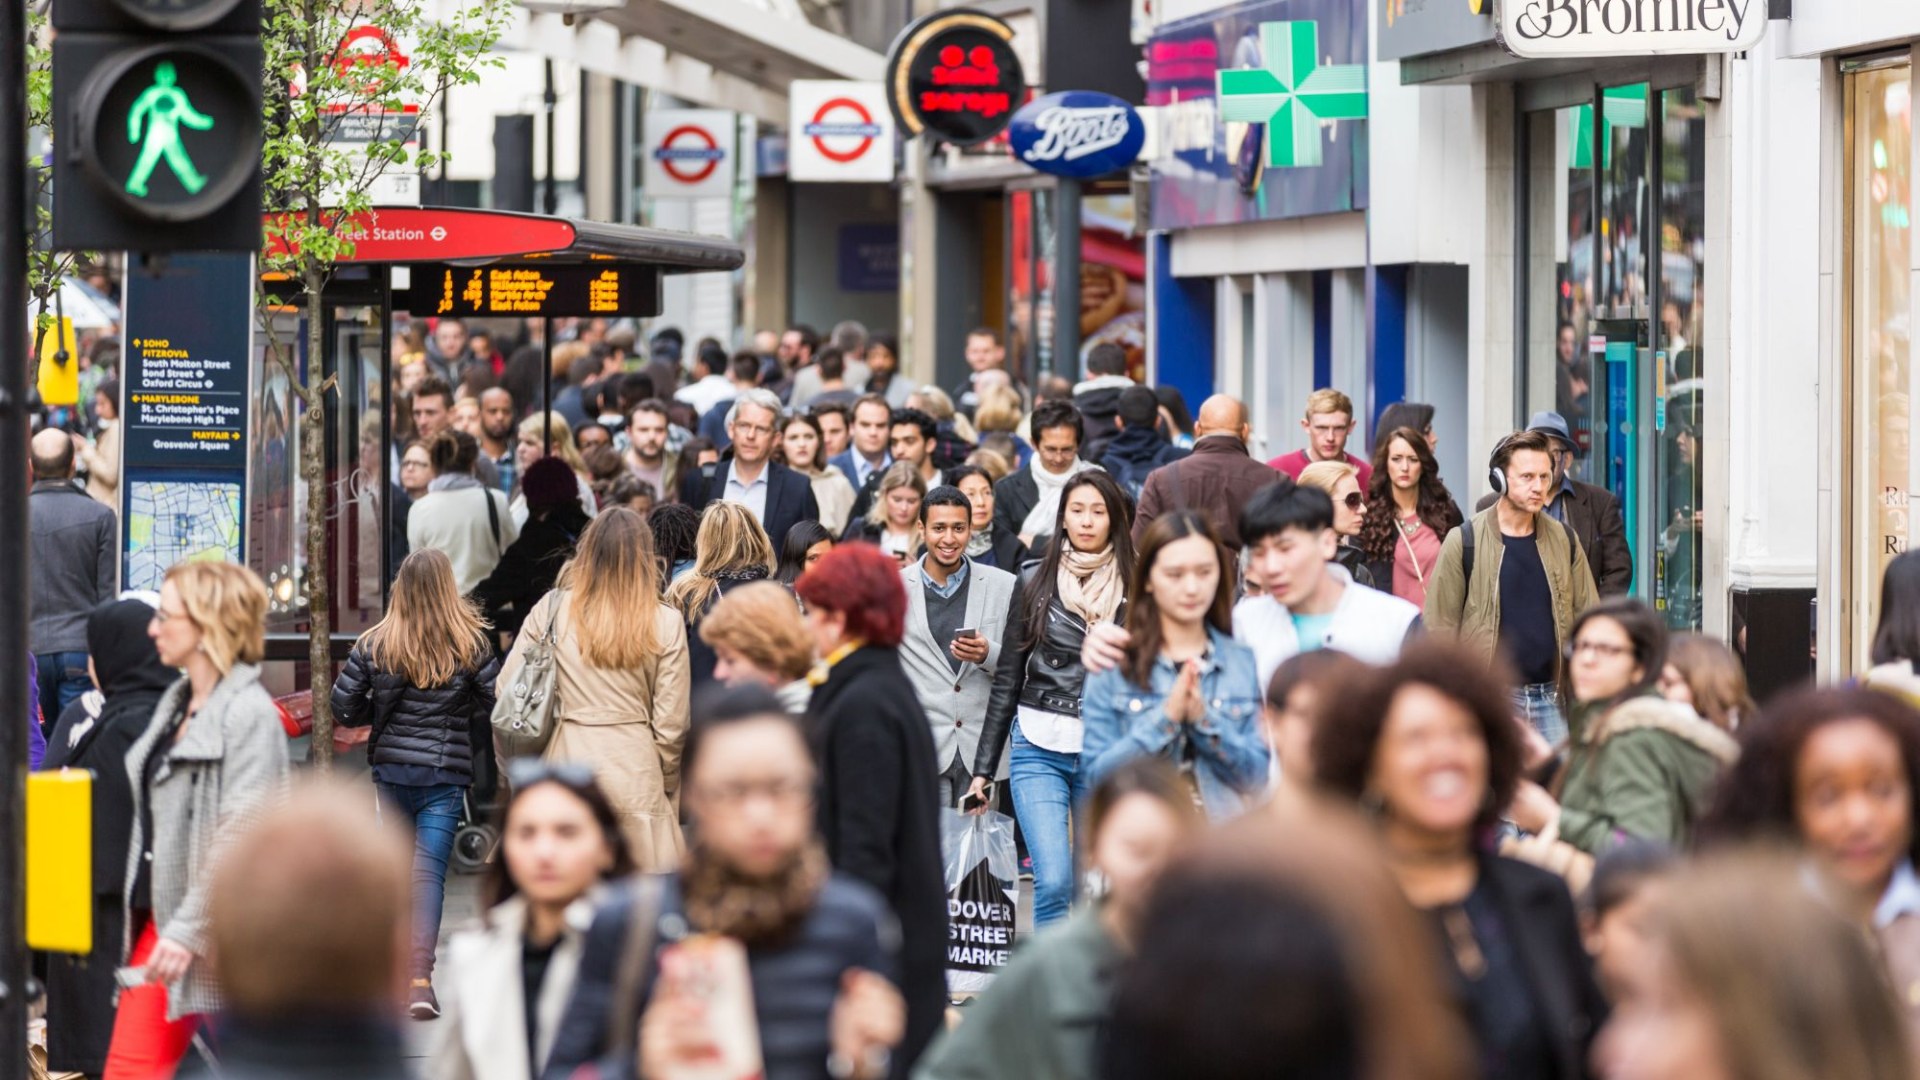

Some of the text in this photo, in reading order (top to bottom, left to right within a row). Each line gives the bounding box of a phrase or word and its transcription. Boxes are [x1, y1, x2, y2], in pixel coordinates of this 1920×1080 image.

[1024, 106, 1130, 161] Boots
[373, 227, 424, 241] Station
[143, 339, 169, 348] SOHO
[142, 349, 189, 358] FITZROVIA
[142, 359, 231, 370] South Molton Street
[142, 369, 194, 378] Bond Street
[142, 379, 203, 388] Oxford Circus
[141, 395, 200, 404] MARYLEBONE
[141, 404, 239, 415] St. Christopher's Place
[141, 414, 226, 426] Marylebone High St
[192, 431, 229, 440] MAYFAIR
[153, 439, 230, 452] Grosvenor Square
[948, 899, 1011, 922] DOVER
[948, 922, 1013, 944] STREET
[948, 945, 1012, 966] MARKE
